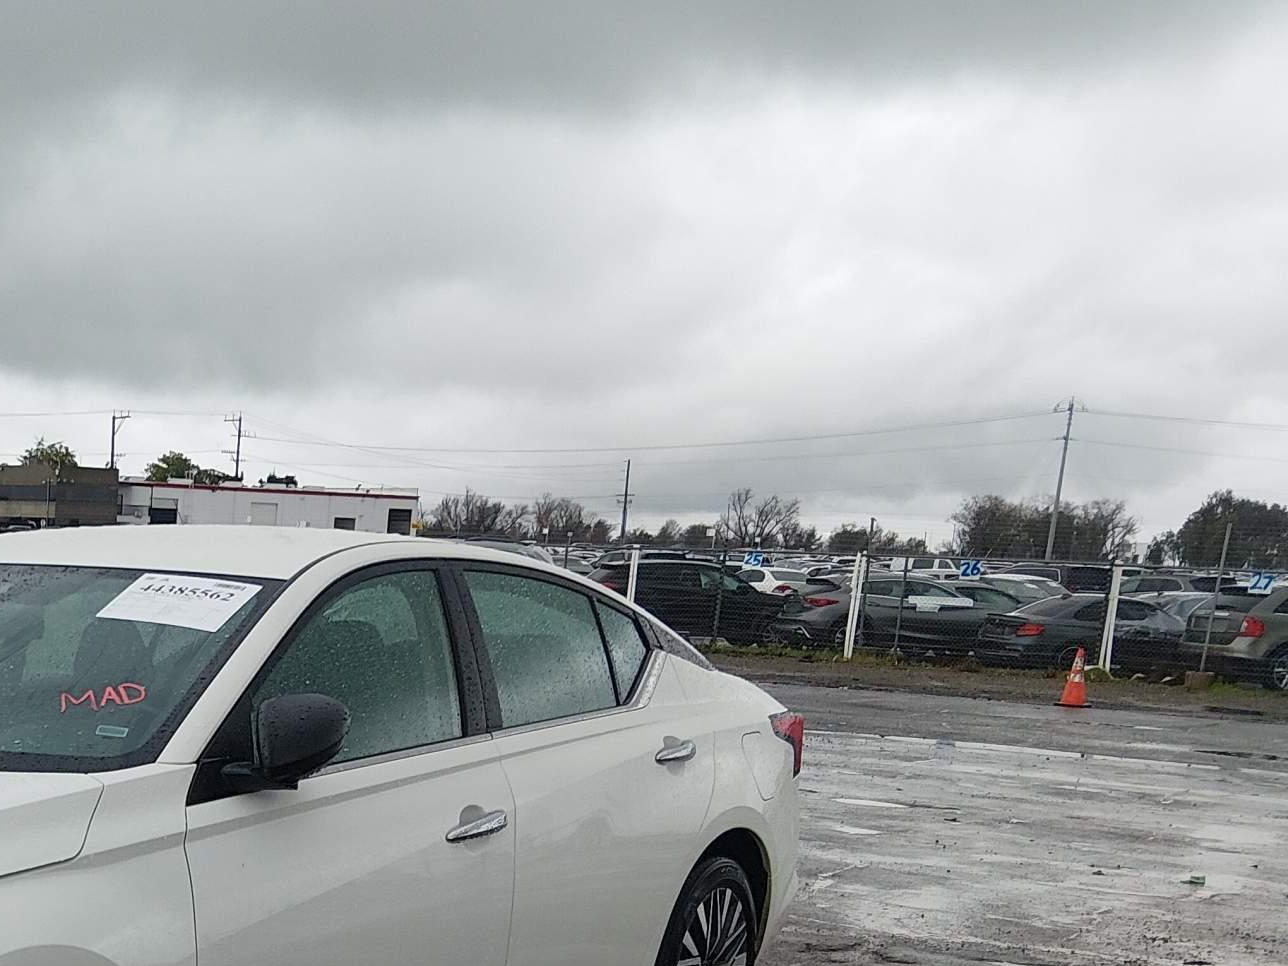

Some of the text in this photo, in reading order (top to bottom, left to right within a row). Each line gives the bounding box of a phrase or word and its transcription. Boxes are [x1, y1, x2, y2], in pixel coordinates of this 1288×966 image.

[744, 551, 762, 566] 25
[960, 560, 981, 577] 26
[1250, 572, 1276, 590] 27
[140, 584, 234, 602] 44385562
[60, 682, 146, 713] MAD
